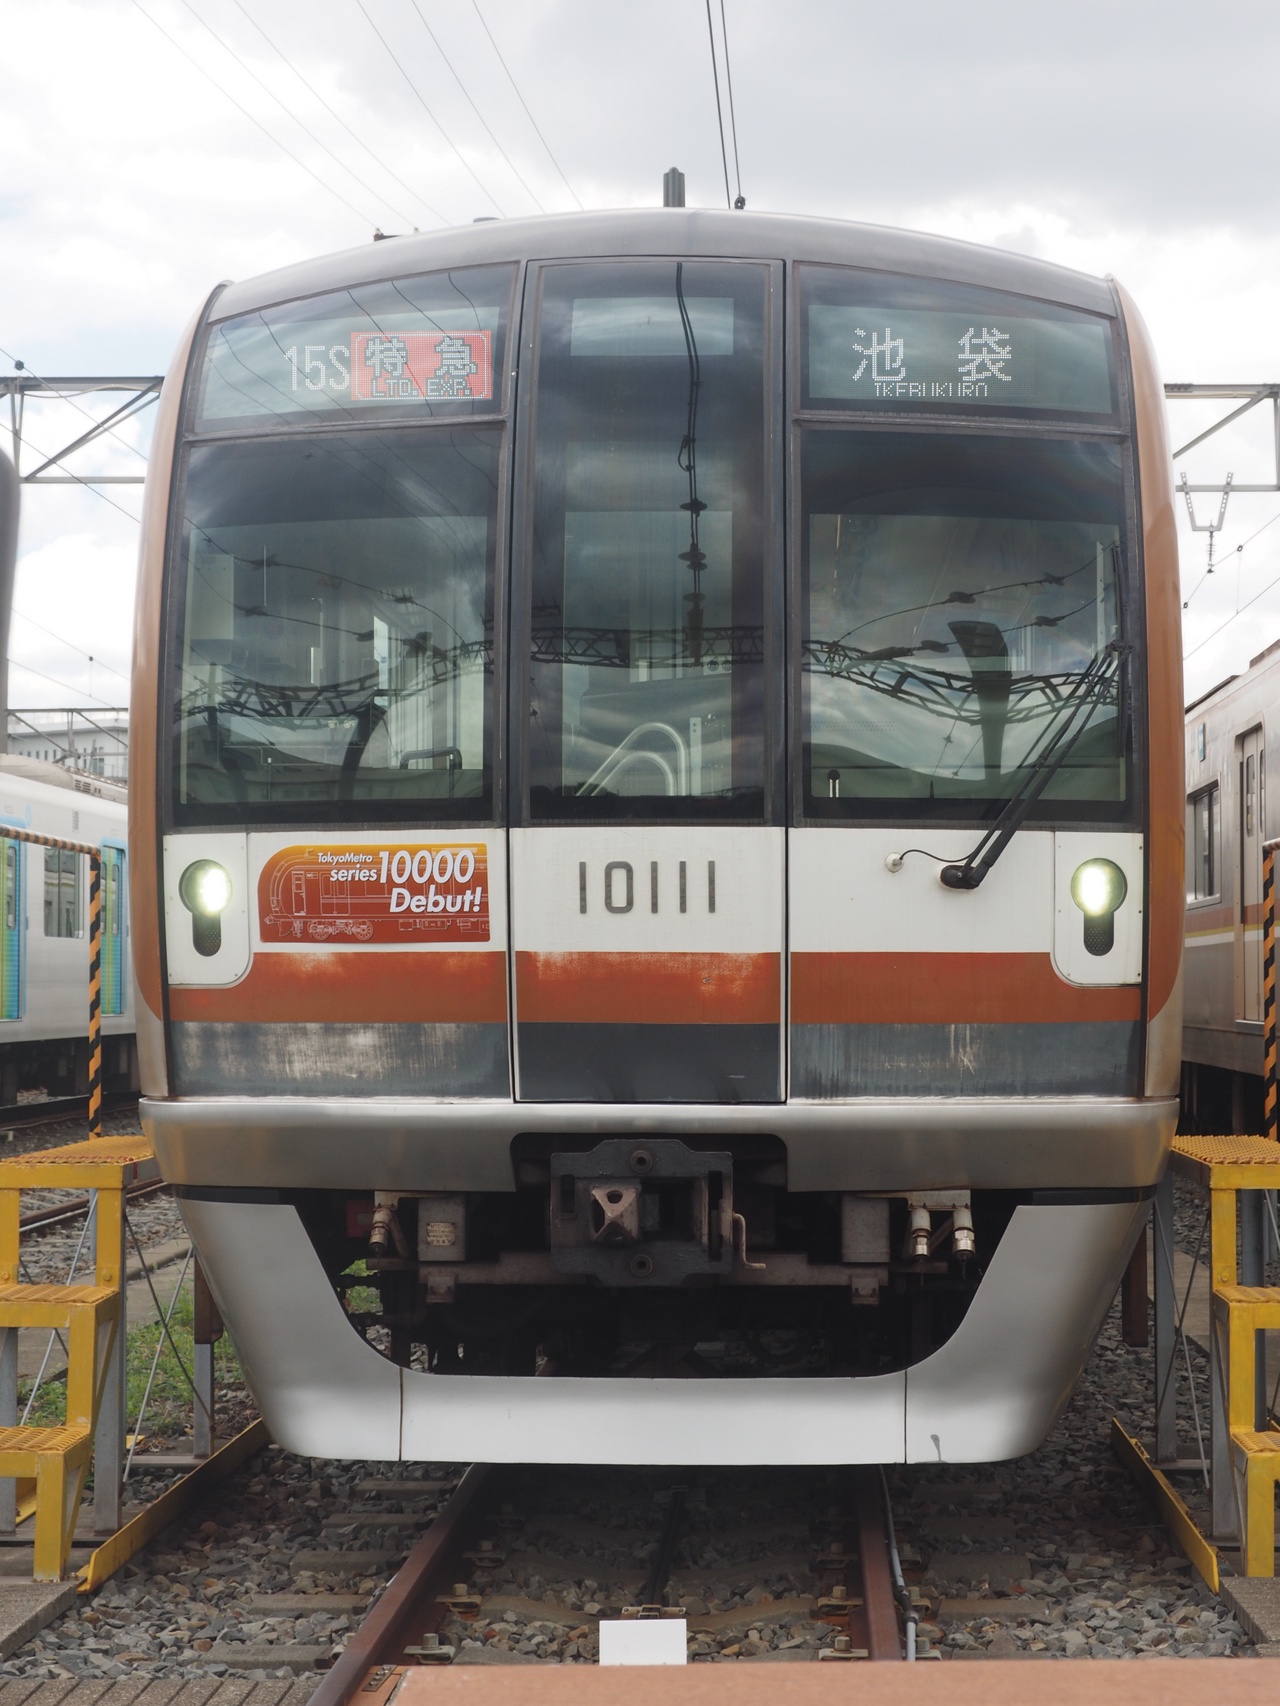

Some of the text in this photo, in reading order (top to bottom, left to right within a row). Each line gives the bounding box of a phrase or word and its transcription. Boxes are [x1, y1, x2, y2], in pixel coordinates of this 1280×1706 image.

[284, 345, 350, 391] 15S
[366, 337, 476, 376] 特急
[852, 328, 1012, 381] 池袋
[372, 378, 471, 396] LTD. EXP.
[330, 850, 475, 884] series 10000
[389, 884, 483, 913] Debut!
[579, 860, 716, 914] 10111
